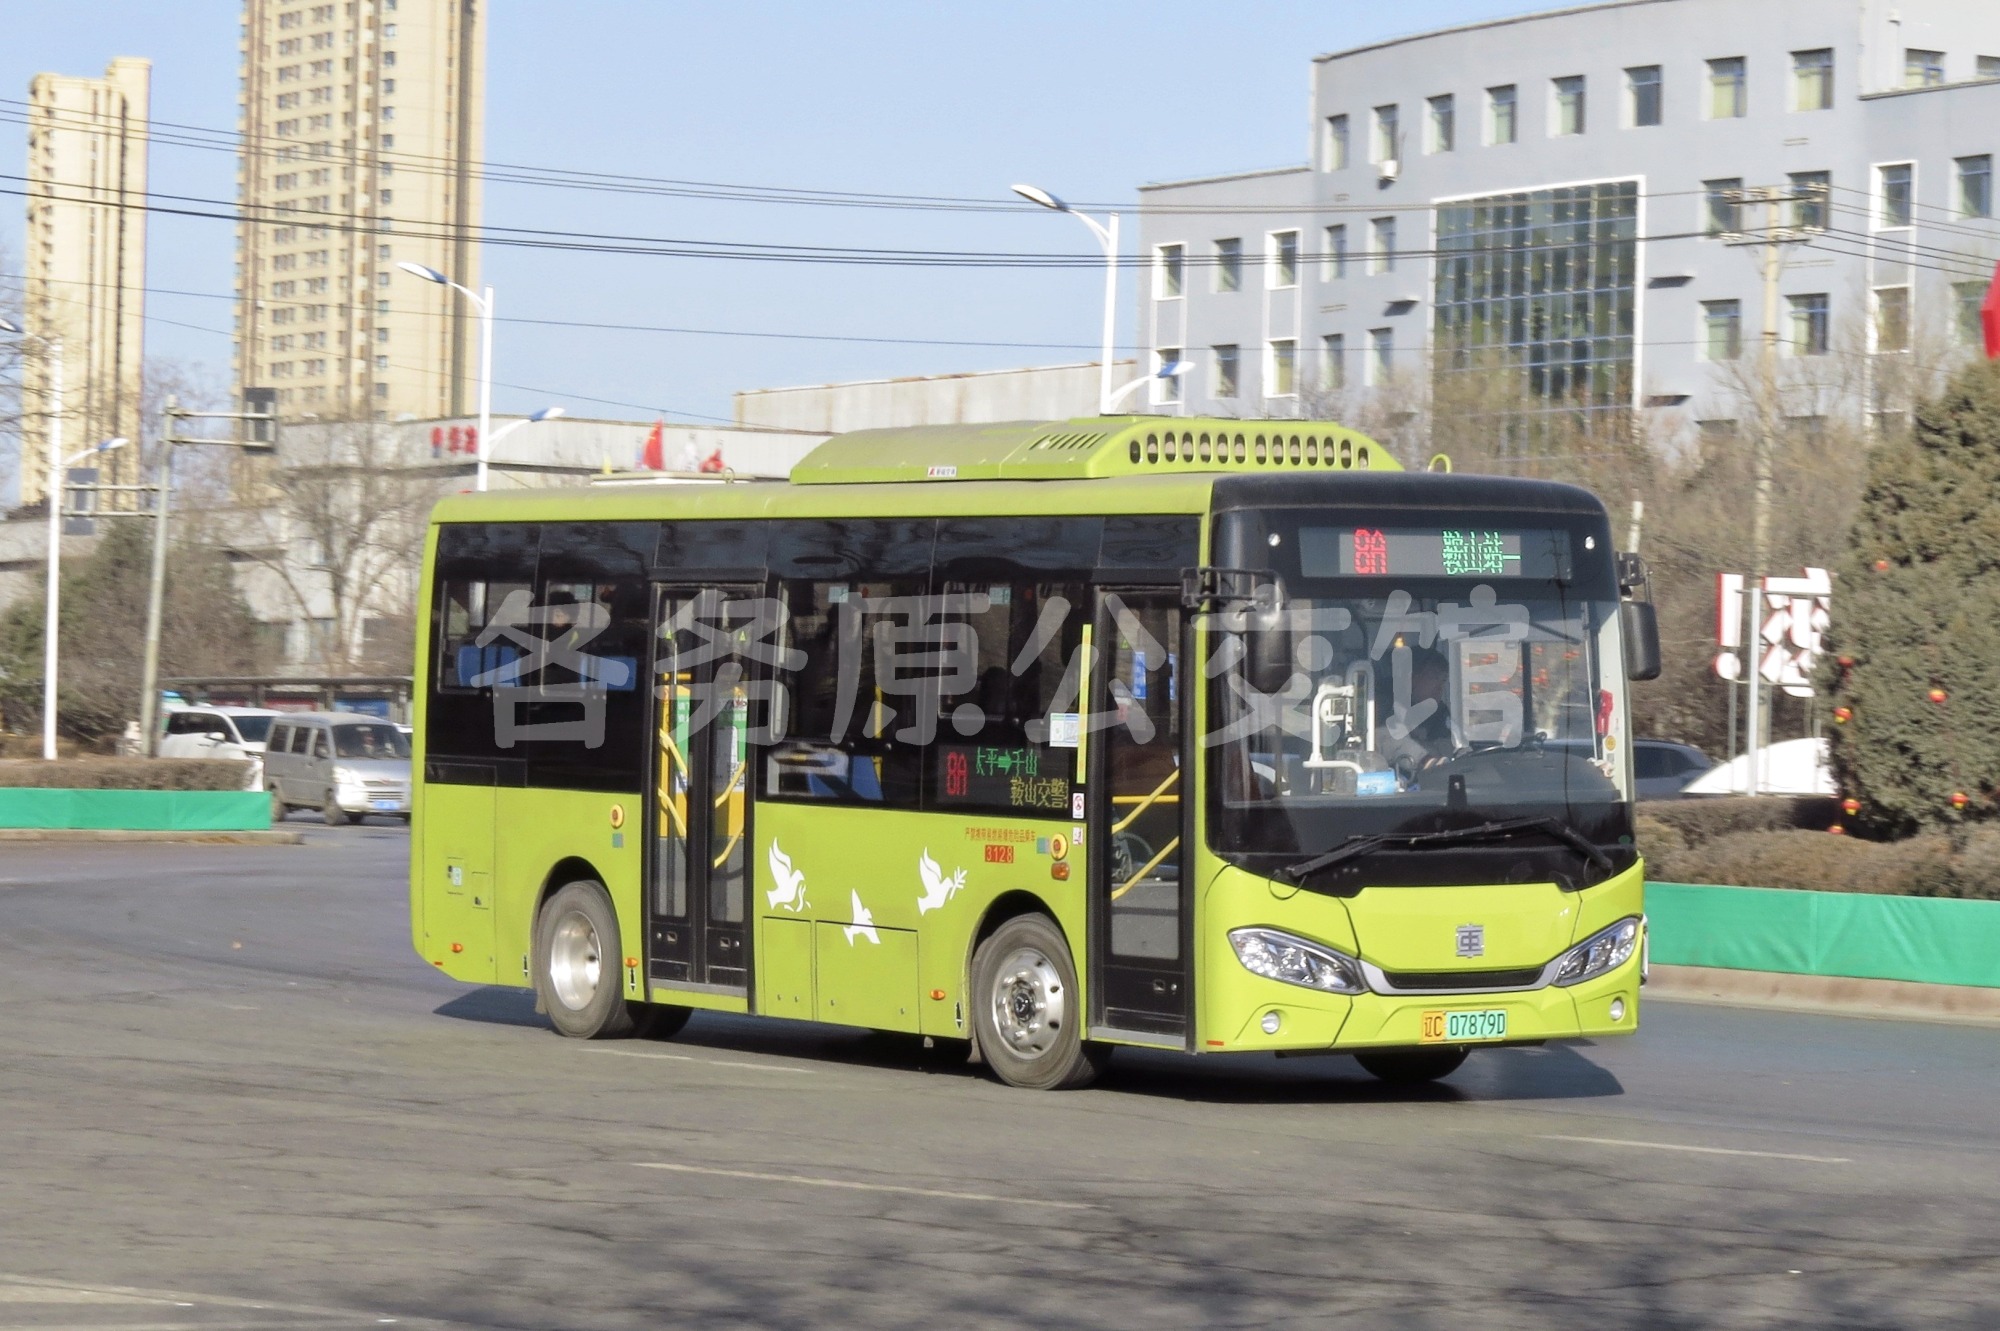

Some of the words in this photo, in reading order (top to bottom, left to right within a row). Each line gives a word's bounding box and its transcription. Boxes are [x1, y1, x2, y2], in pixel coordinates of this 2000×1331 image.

[946, 752, 968, 796] 8A
[1010, 777, 1069, 809] 鞍山交警
[986, 846, 1013, 863] 3128
